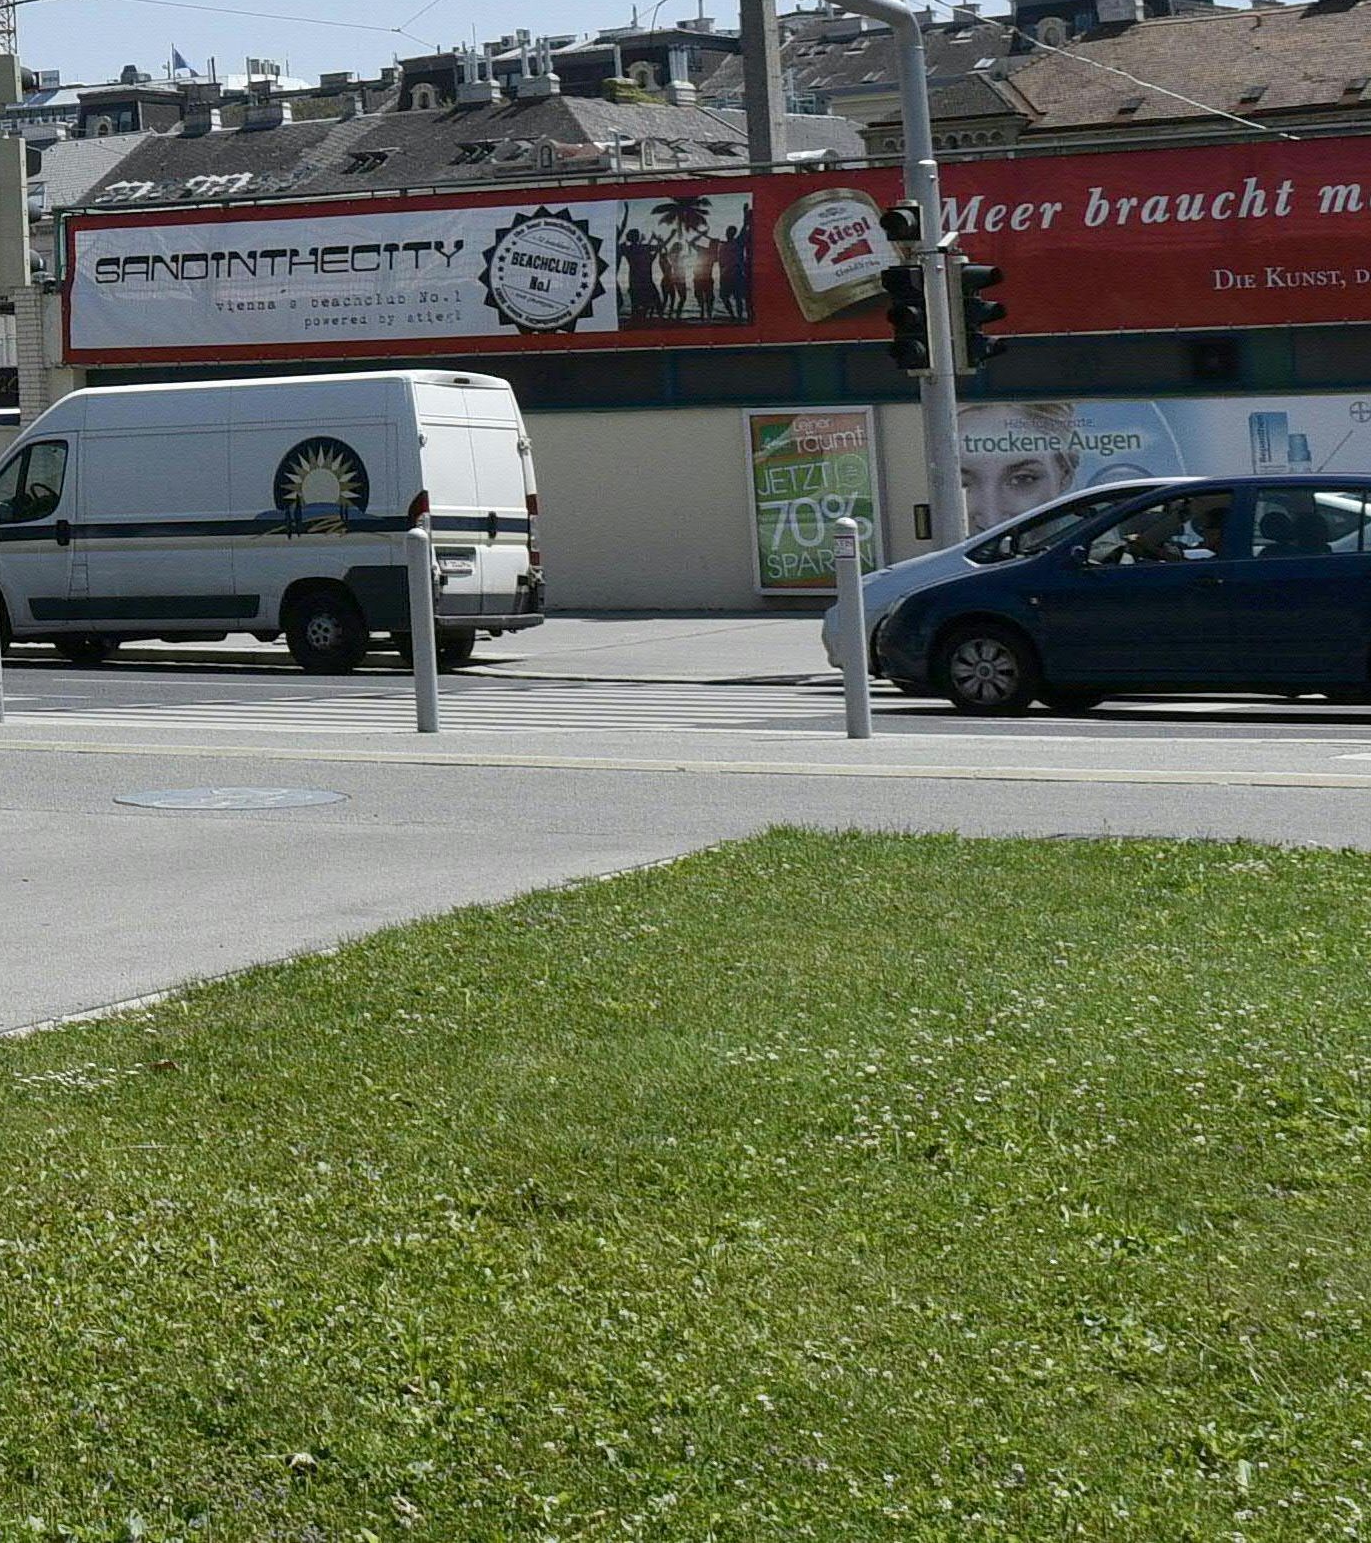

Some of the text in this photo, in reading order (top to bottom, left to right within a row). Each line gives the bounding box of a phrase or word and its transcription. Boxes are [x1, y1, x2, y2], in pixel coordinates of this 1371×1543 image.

[940, 176, 1371, 235] Meer braucht m
[807, 216, 871, 265] Stiegl
[94, 239, 464, 285] SANDINTHECITY
[510, 251, 579, 276] BEACHCLUB
[1211, 266, 1371, 291] DIE KUNST, D
[310, 293, 406, 309] beachclub
[304, 313, 368, 330] powered
[378, 312, 395, 329] by
[795, 426, 866, 454] räumt
[963, 430, 1142, 456] trockene Augen
[758, 461, 832, 496] JETZT
[766, 543, 875, 580] SPARN
